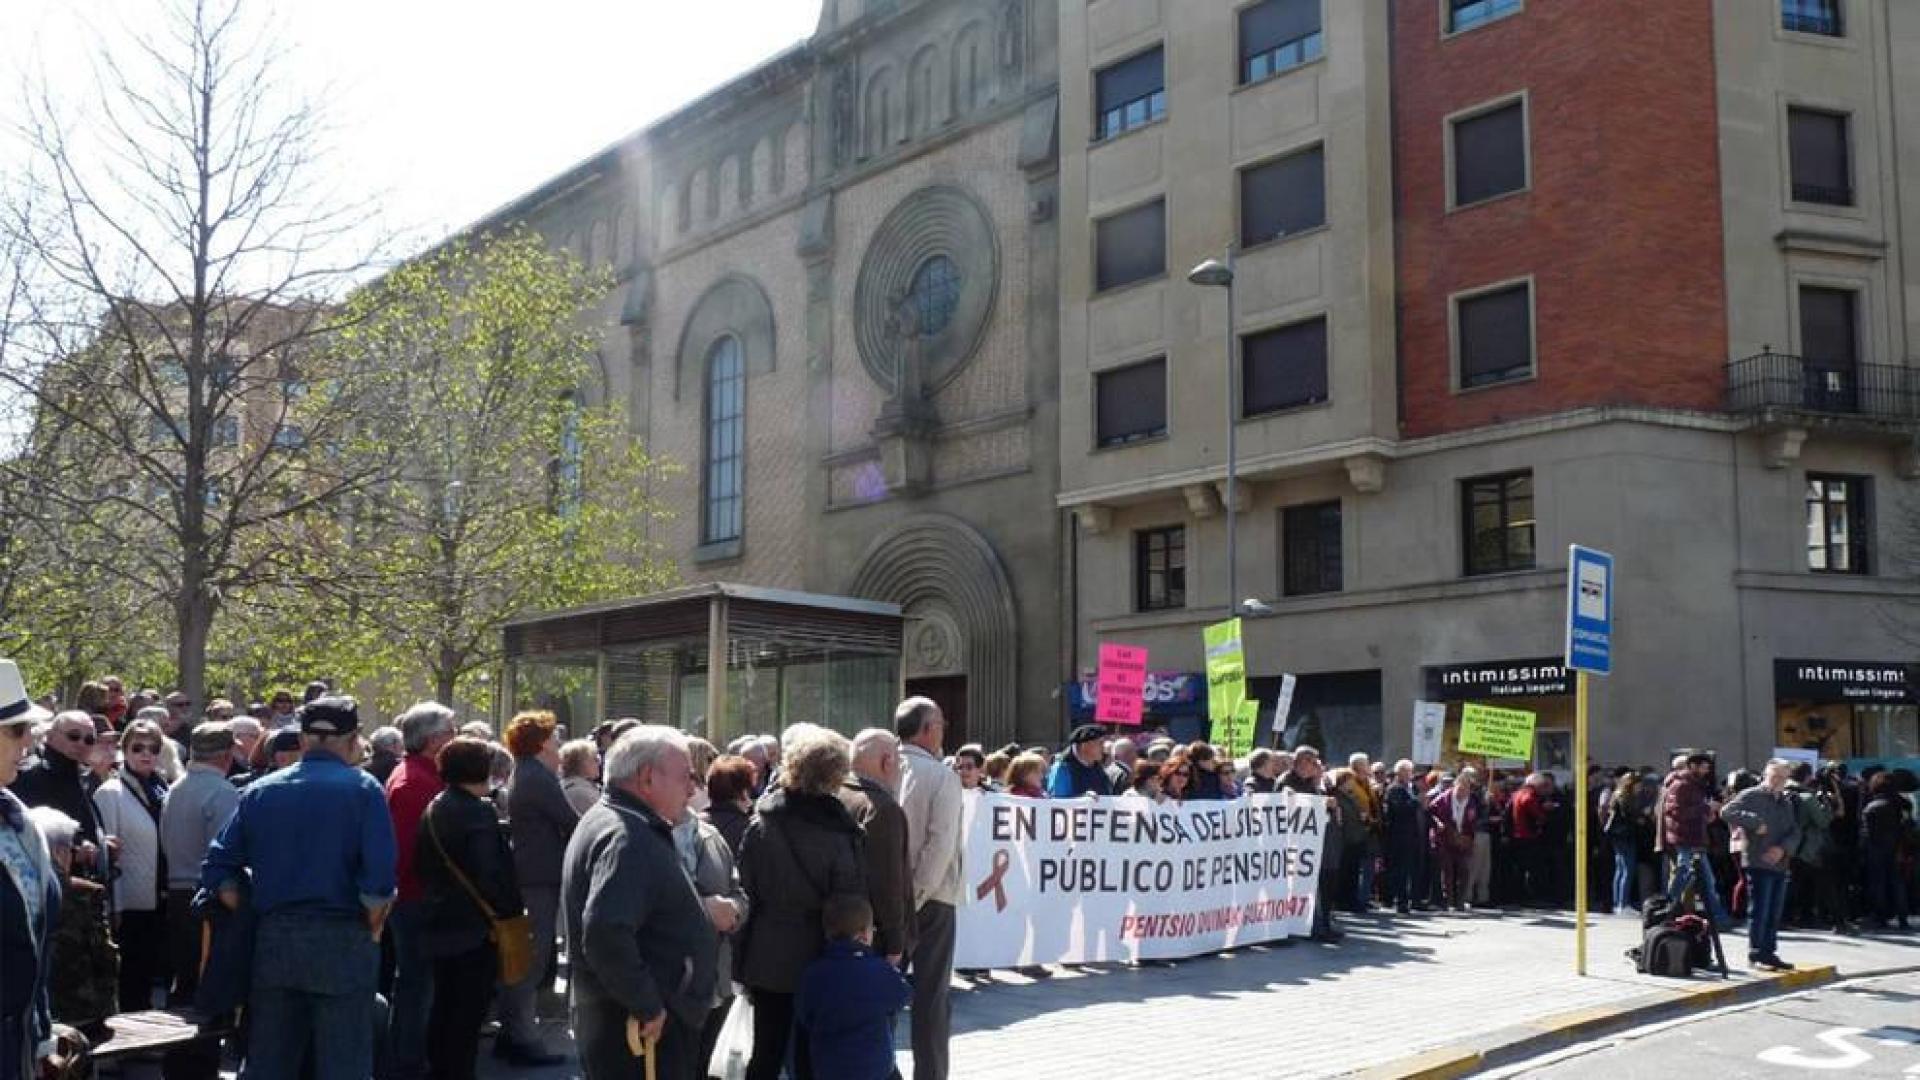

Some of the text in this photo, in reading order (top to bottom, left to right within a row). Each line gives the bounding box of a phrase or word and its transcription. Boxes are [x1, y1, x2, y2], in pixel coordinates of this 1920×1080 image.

[1442, 666, 1566, 684] intimissimi
[1799, 666, 1905, 682] intimissimi
[992, 806, 1318, 844] EN DEFENSA DEL SISTEMA
[1039, 848, 1315, 893] PÚBLICO DE PENSIOES
[1119, 914, 1196, 940] PENTSIO
